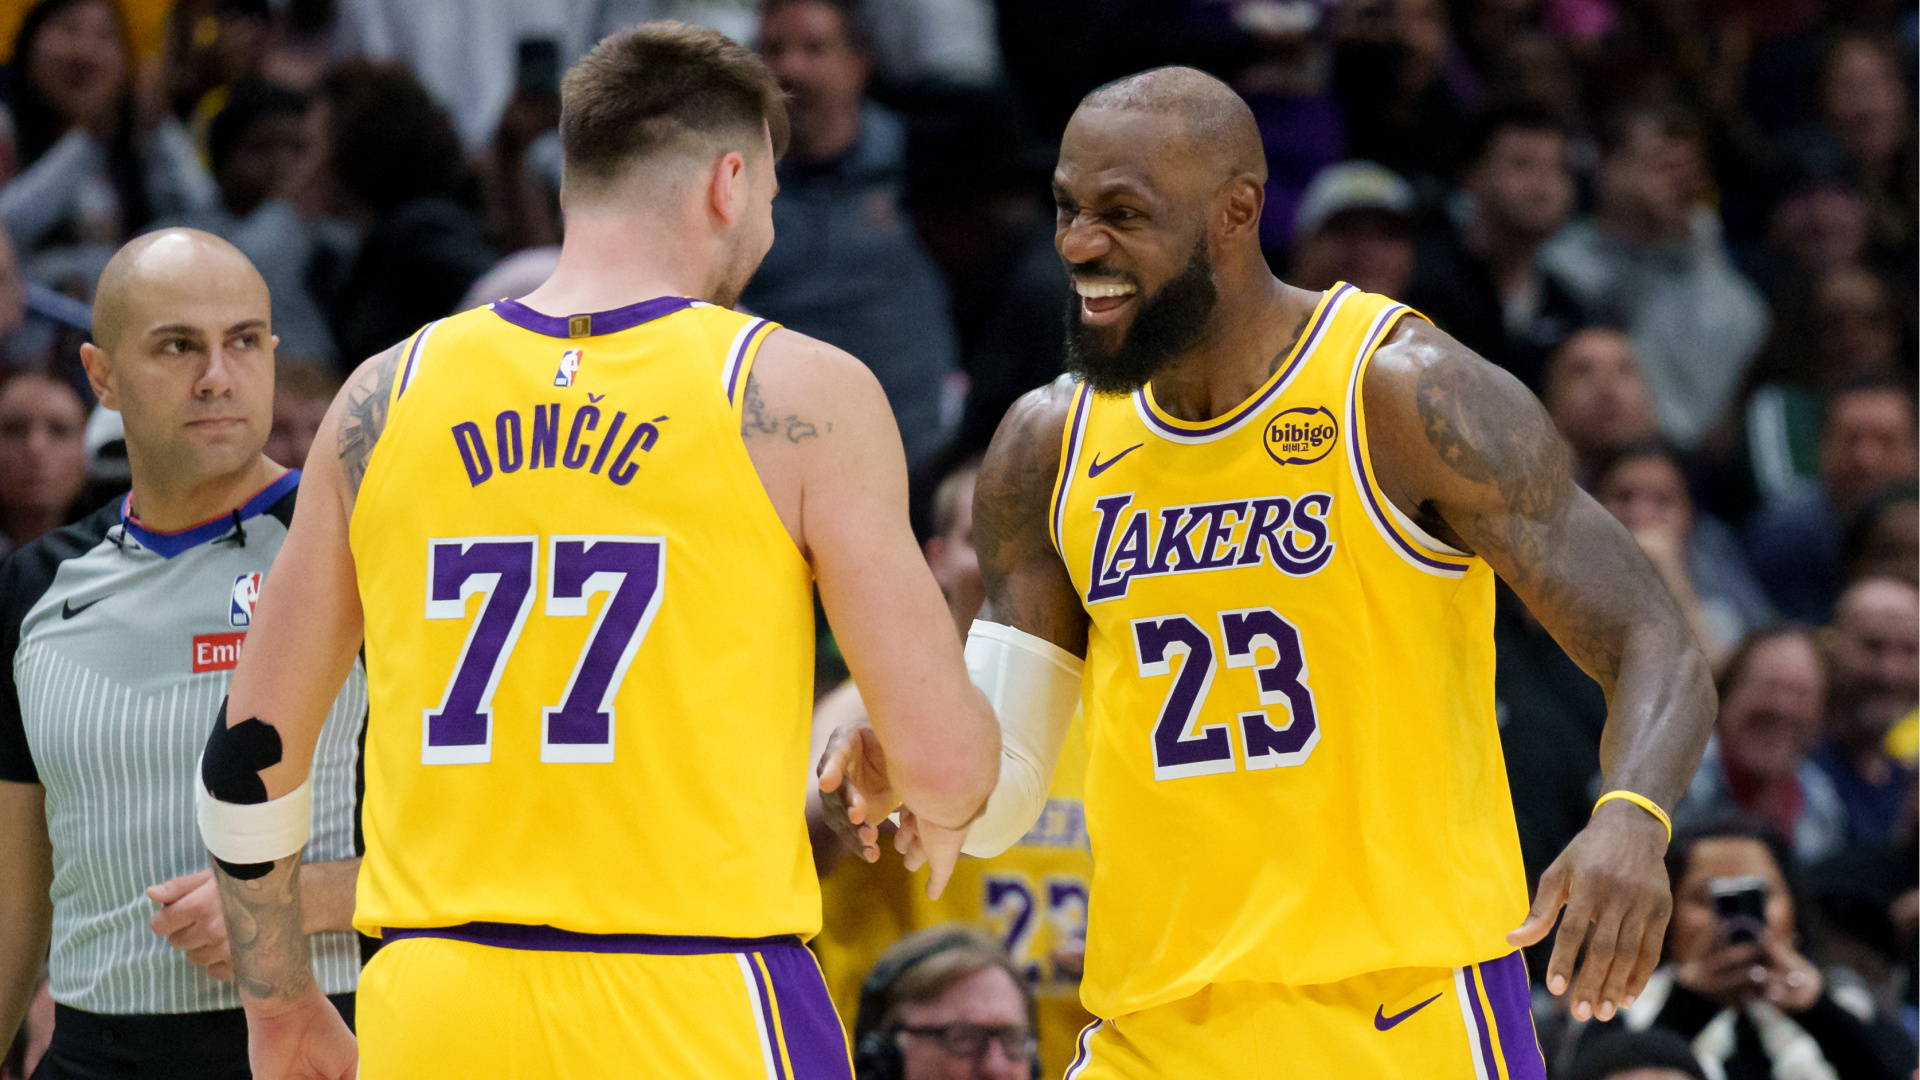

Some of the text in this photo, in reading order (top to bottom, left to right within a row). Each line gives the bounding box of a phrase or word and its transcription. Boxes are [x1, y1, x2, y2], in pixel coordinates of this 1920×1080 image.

[451, 392, 669, 487] DONČIĆ
[1271, 422, 1334, 447] bibigo
[1282, 442, 1309, 453] 비비고
[1086, 491, 1337, 606] LAKERS
[421, 534, 667, 765] 77
[1130, 606, 1322, 782] 23
